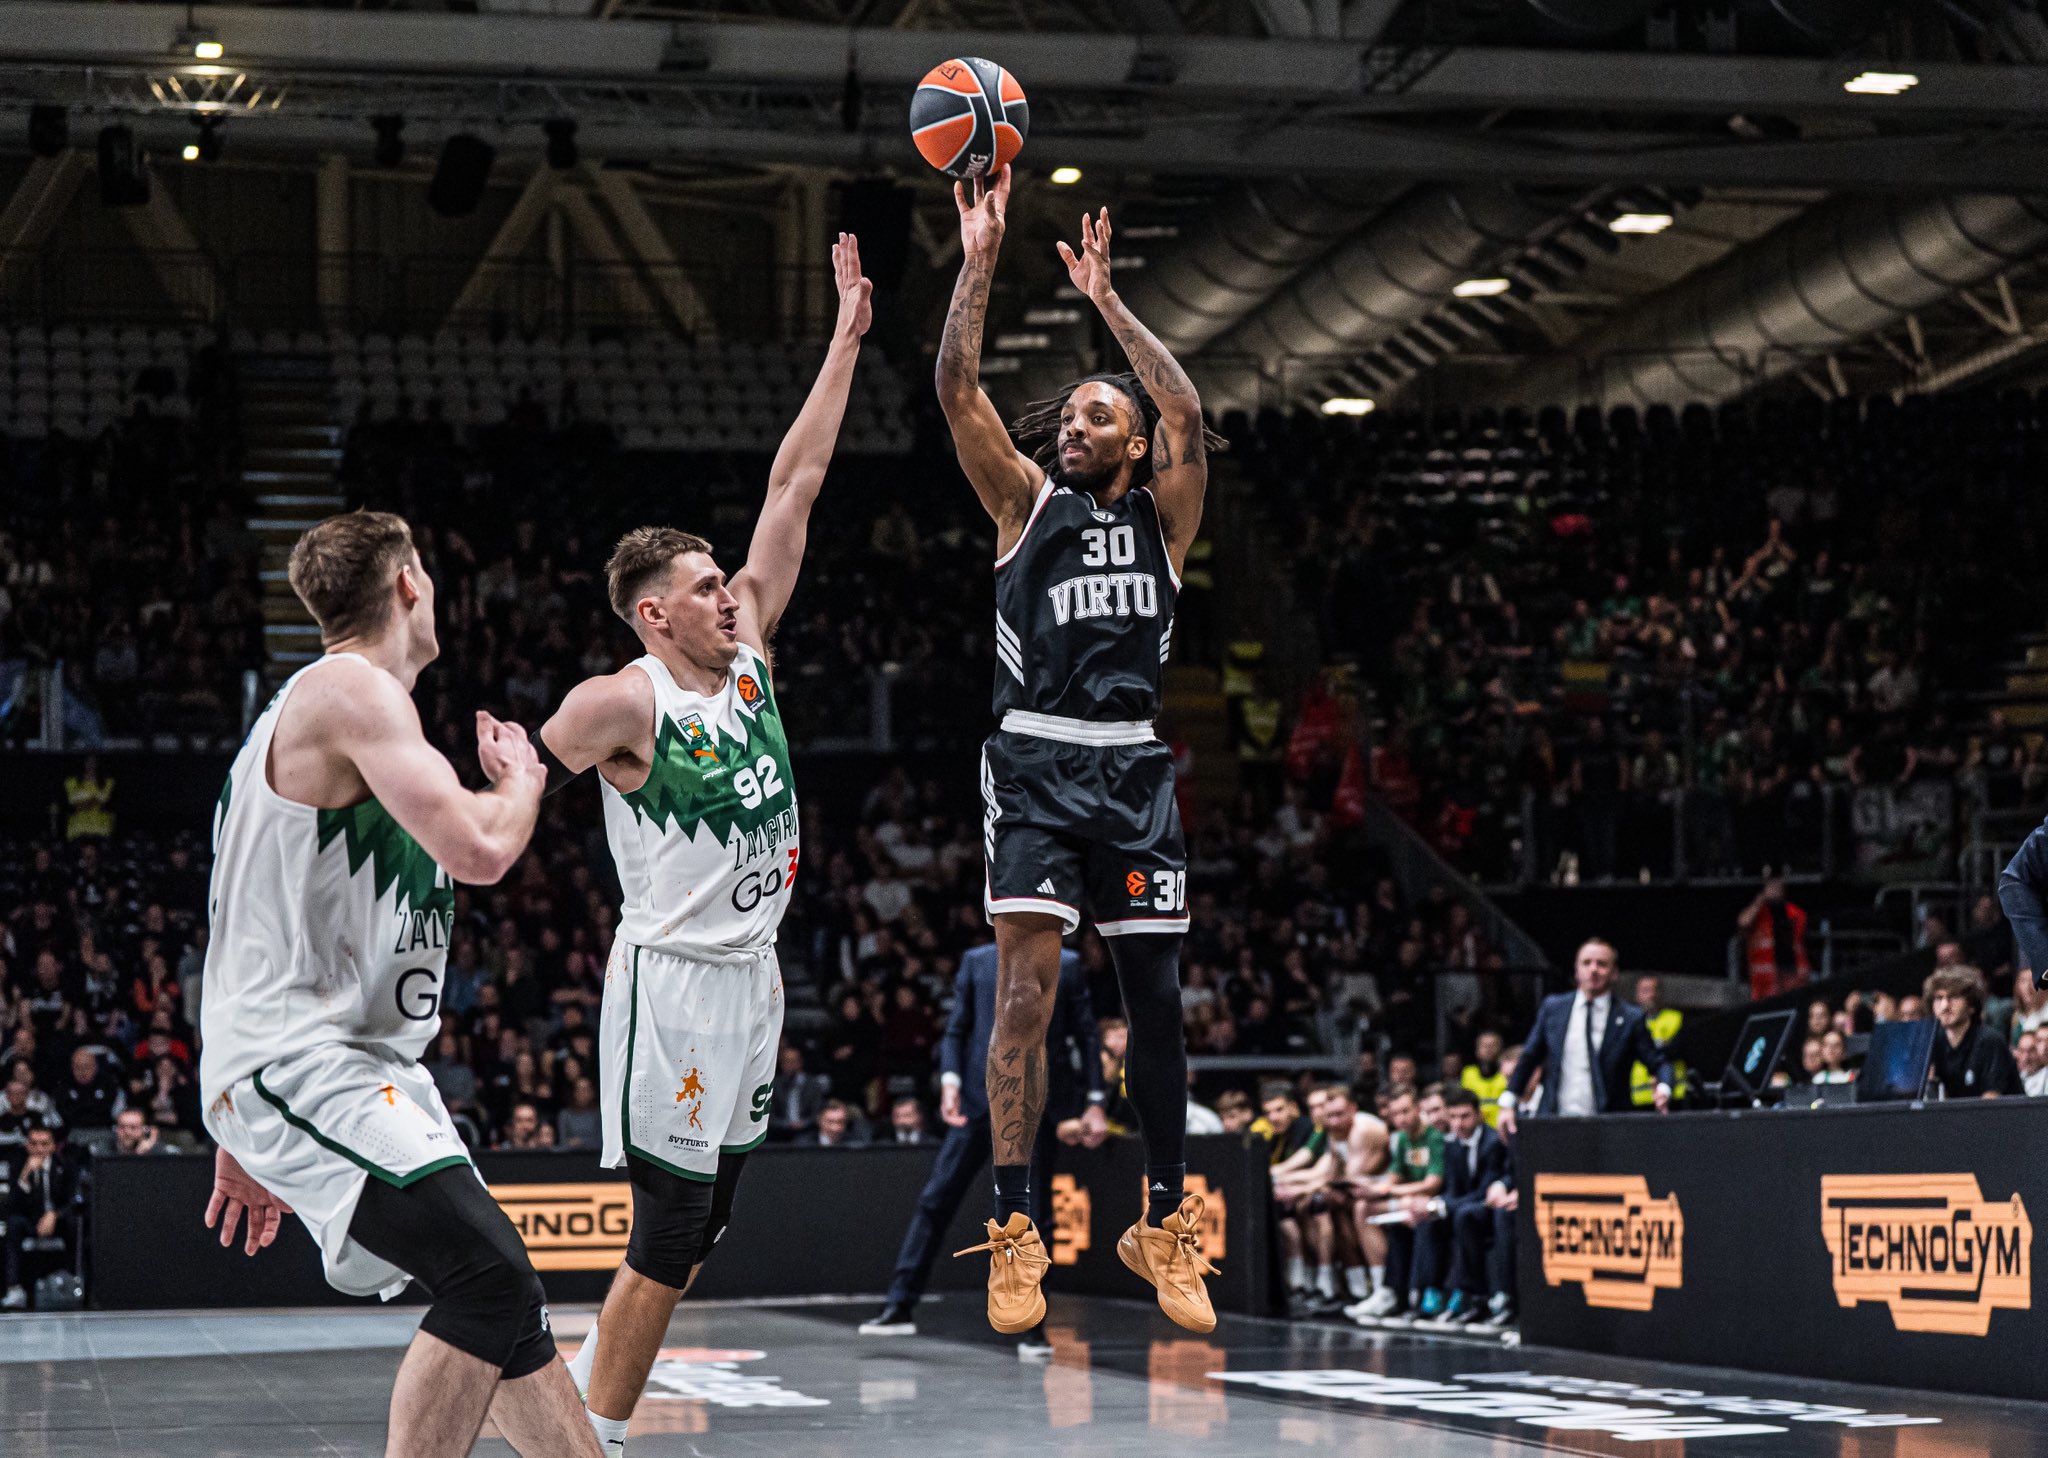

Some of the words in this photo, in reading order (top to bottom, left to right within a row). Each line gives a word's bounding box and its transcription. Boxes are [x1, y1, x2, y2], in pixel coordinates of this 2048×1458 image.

[1081, 525, 1136, 567] 30
[1048, 572, 1158, 626] VIRTU
[733, 754, 785, 810] 92
[1153, 870, 1186, 911] 30
[395, 967, 438, 1021] G
